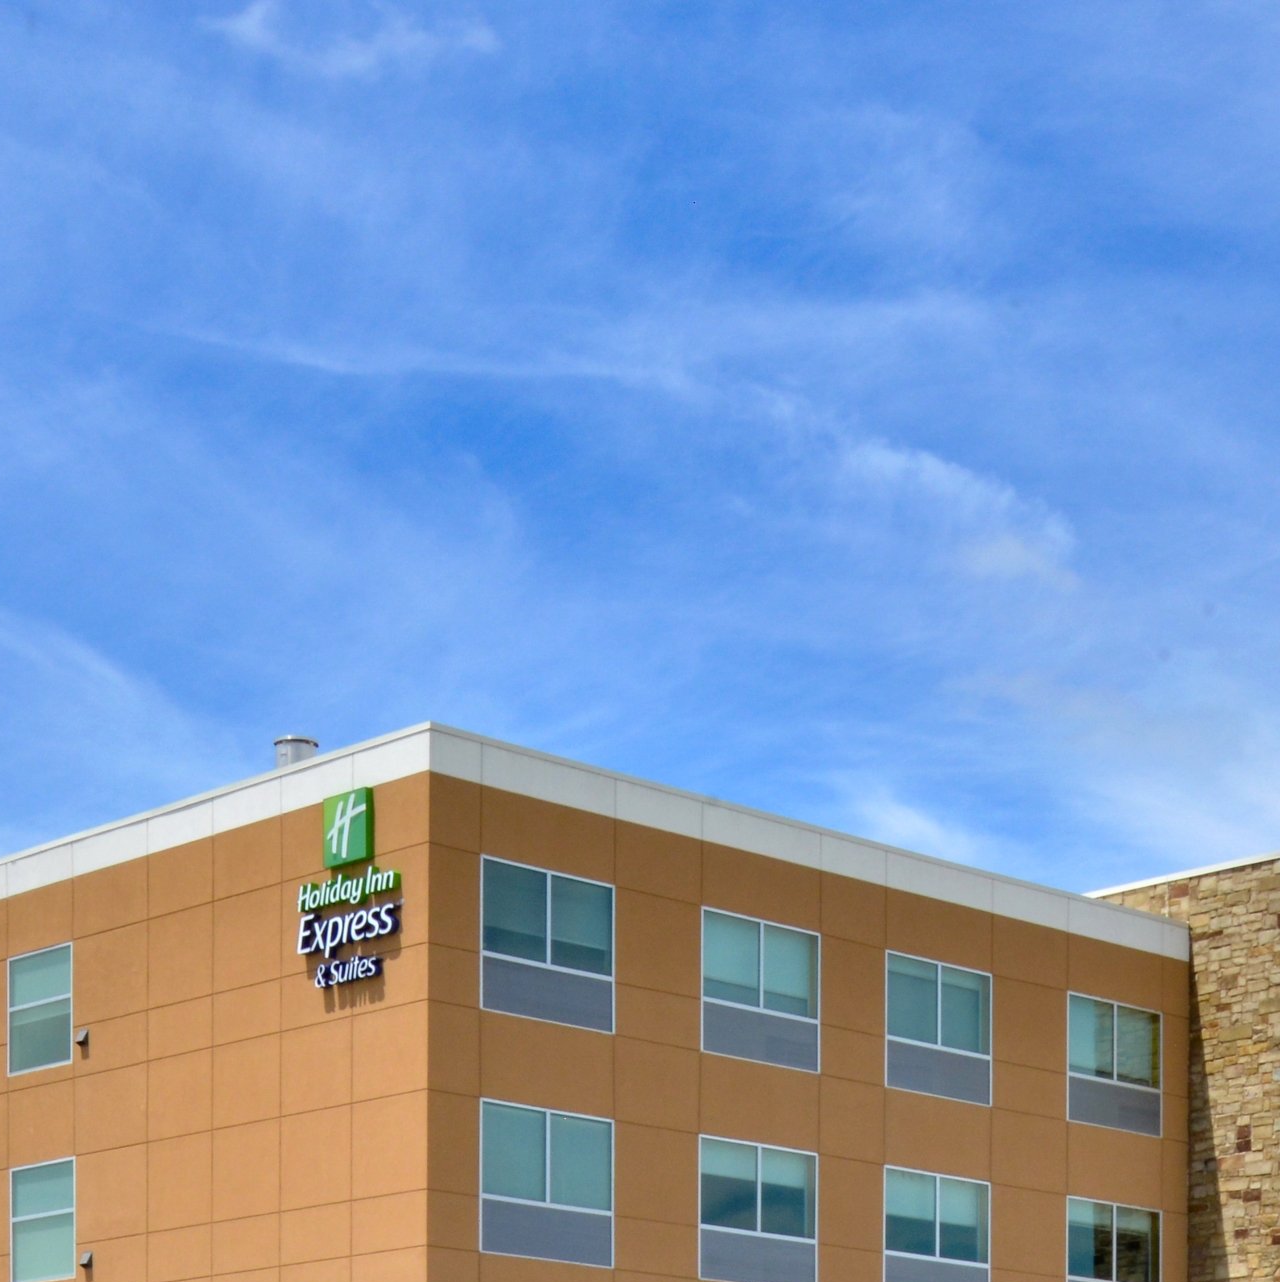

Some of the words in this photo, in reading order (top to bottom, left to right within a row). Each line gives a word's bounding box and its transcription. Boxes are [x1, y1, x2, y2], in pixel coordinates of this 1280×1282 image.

[298, 874, 363, 912] Holiday
[365, 865, 395, 895] Inn
[296, 902, 395, 958] Express
[314, 963, 326, 989] &
[328, 956, 377, 986] Suites
